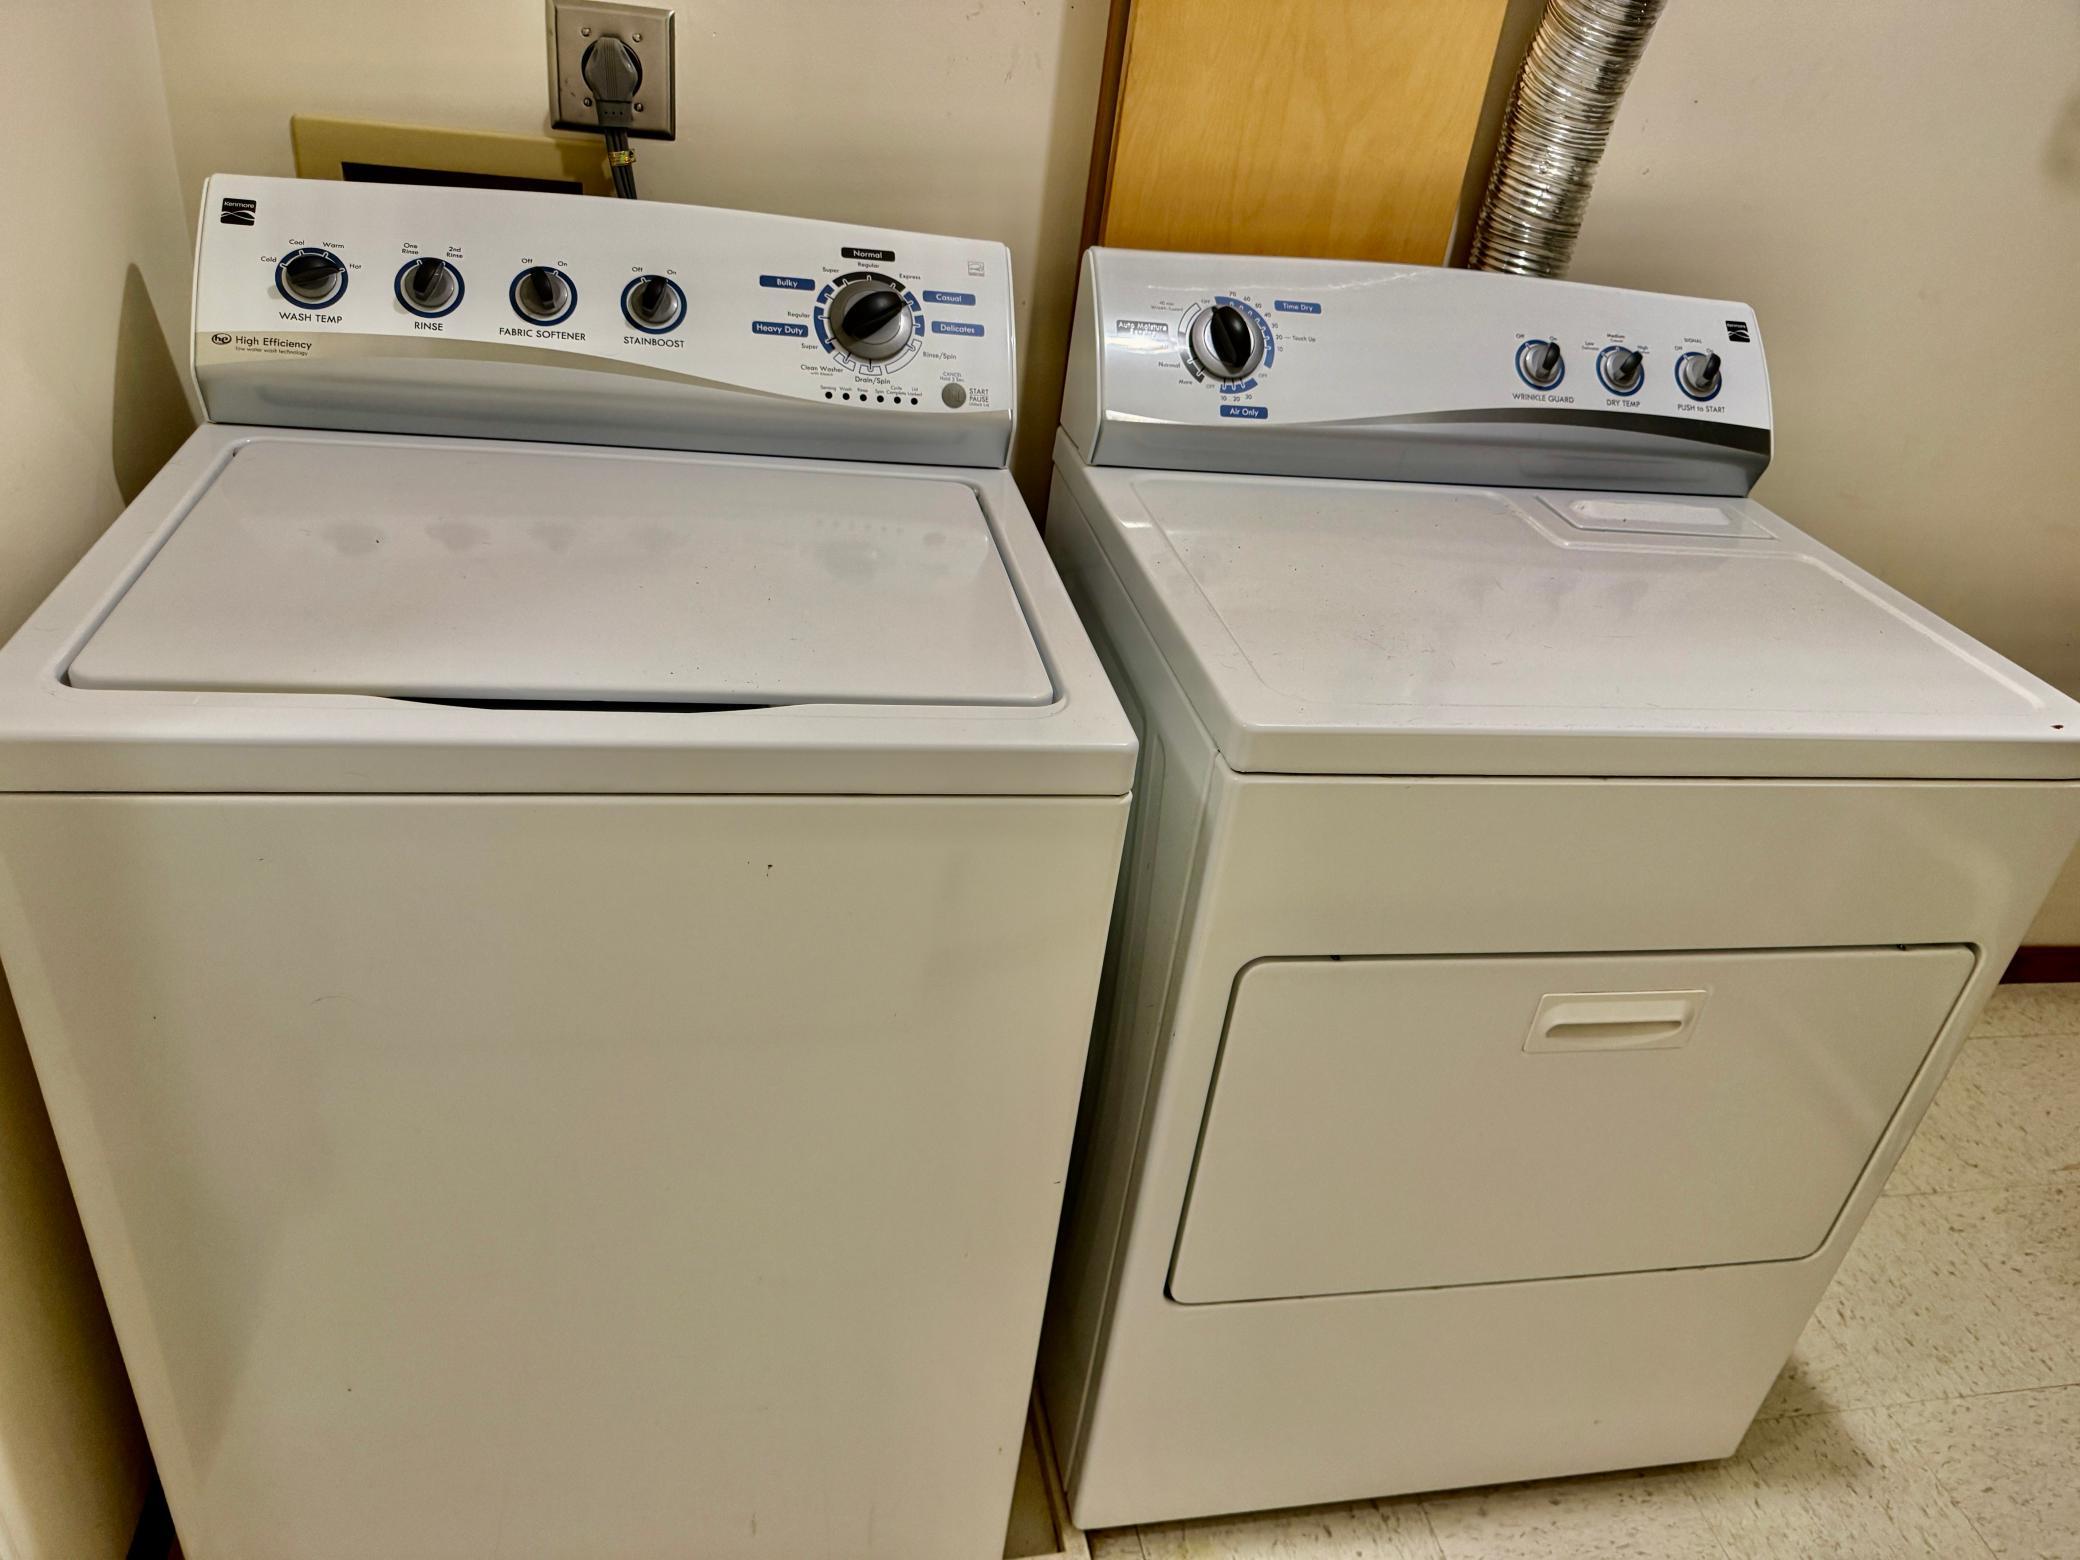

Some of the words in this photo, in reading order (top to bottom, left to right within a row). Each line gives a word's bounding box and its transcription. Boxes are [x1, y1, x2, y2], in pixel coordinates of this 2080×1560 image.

[322, 241, 345, 249] Warm
[260, 255, 277, 263] Cold
[446, 251, 463, 259] Rinse
[853, 250, 883, 259] Normal
[857, 261, 880, 269] Regular
[899, 273, 921, 281] Express
[776, 279, 798, 288] Bulky
[935, 293, 962, 302] Casual
[1301, 304, 1313, 312] Dry
[279, 312, 311, 322] WASH
[316, 314, 343, 324] TEMP
[787, 311, 810, 319] Regular
[414, 321, 444, 332] RINSE
[940, 323, 975, 334] Delicates
[1118, 321, 1135, 329] Auto
[499, 328, 532, 338] FABRIC
[536, 330, 586, 341] SOFTENER
[756, 324, 783, 334] Heavy
[785, 326, 804, 336] Duty
[235, 335, 259, 347] High
[263, 337, 312, 350] Efficiency
[623, 336, 685, 348] STAINBOOST
[801, 343, 818, 351] Super
[923, 351, 957, 360] Rinse/Spin
[820, 365, 843, 373] Washer
[1158, 361, 1180, 369] Normal
[855, 376, 891, 385] Drain/Spin
[1512, 393, 1547, 402] WRINKLE
[1548, 394, 1575, 404] GUARD
[1606, 399, 1621, 407] DRY
[1622, 400, 1640, 408] TEMP
[1677, 403, 1695, 412] PUSH
[1705, 405, 1725, 413] START
[1241, 408, 1259, 417] Only
